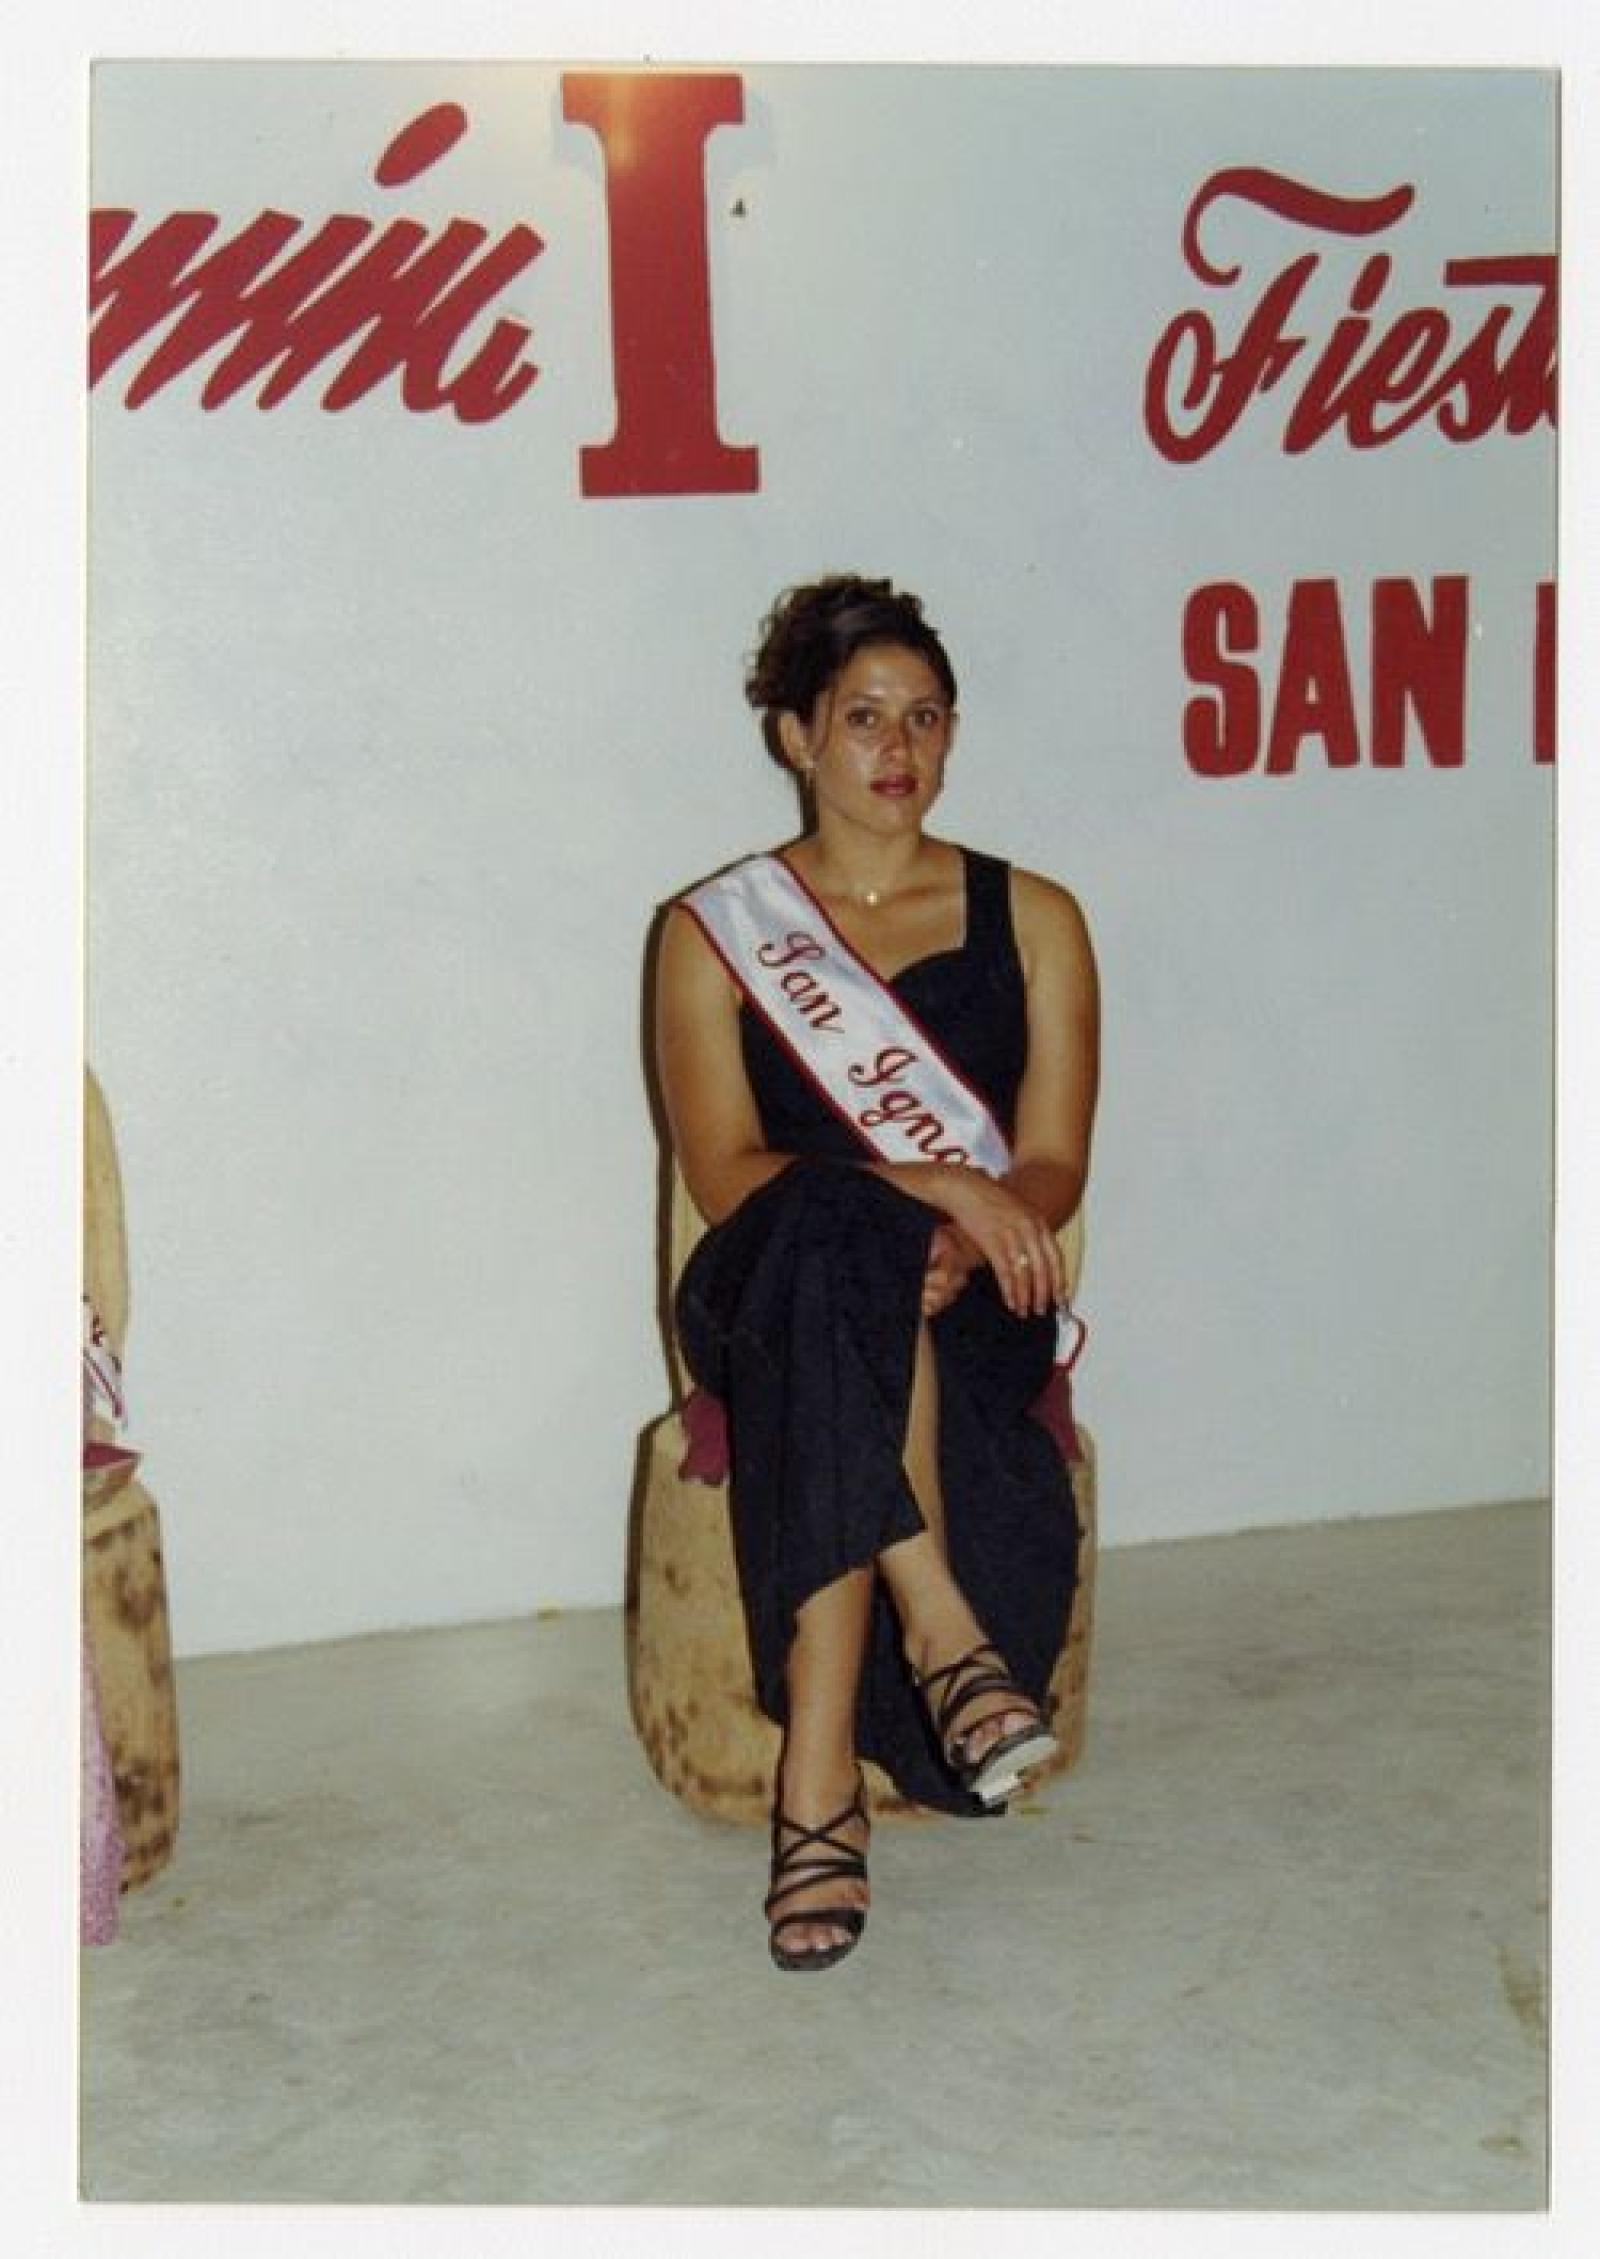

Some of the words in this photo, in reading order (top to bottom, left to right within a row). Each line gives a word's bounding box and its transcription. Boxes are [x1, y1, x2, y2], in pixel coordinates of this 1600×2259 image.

[1146, 168, 1558, 462] Fiest
[1183, 576, 1468, 778] SAN
[758, 931, 845, 1034] San
